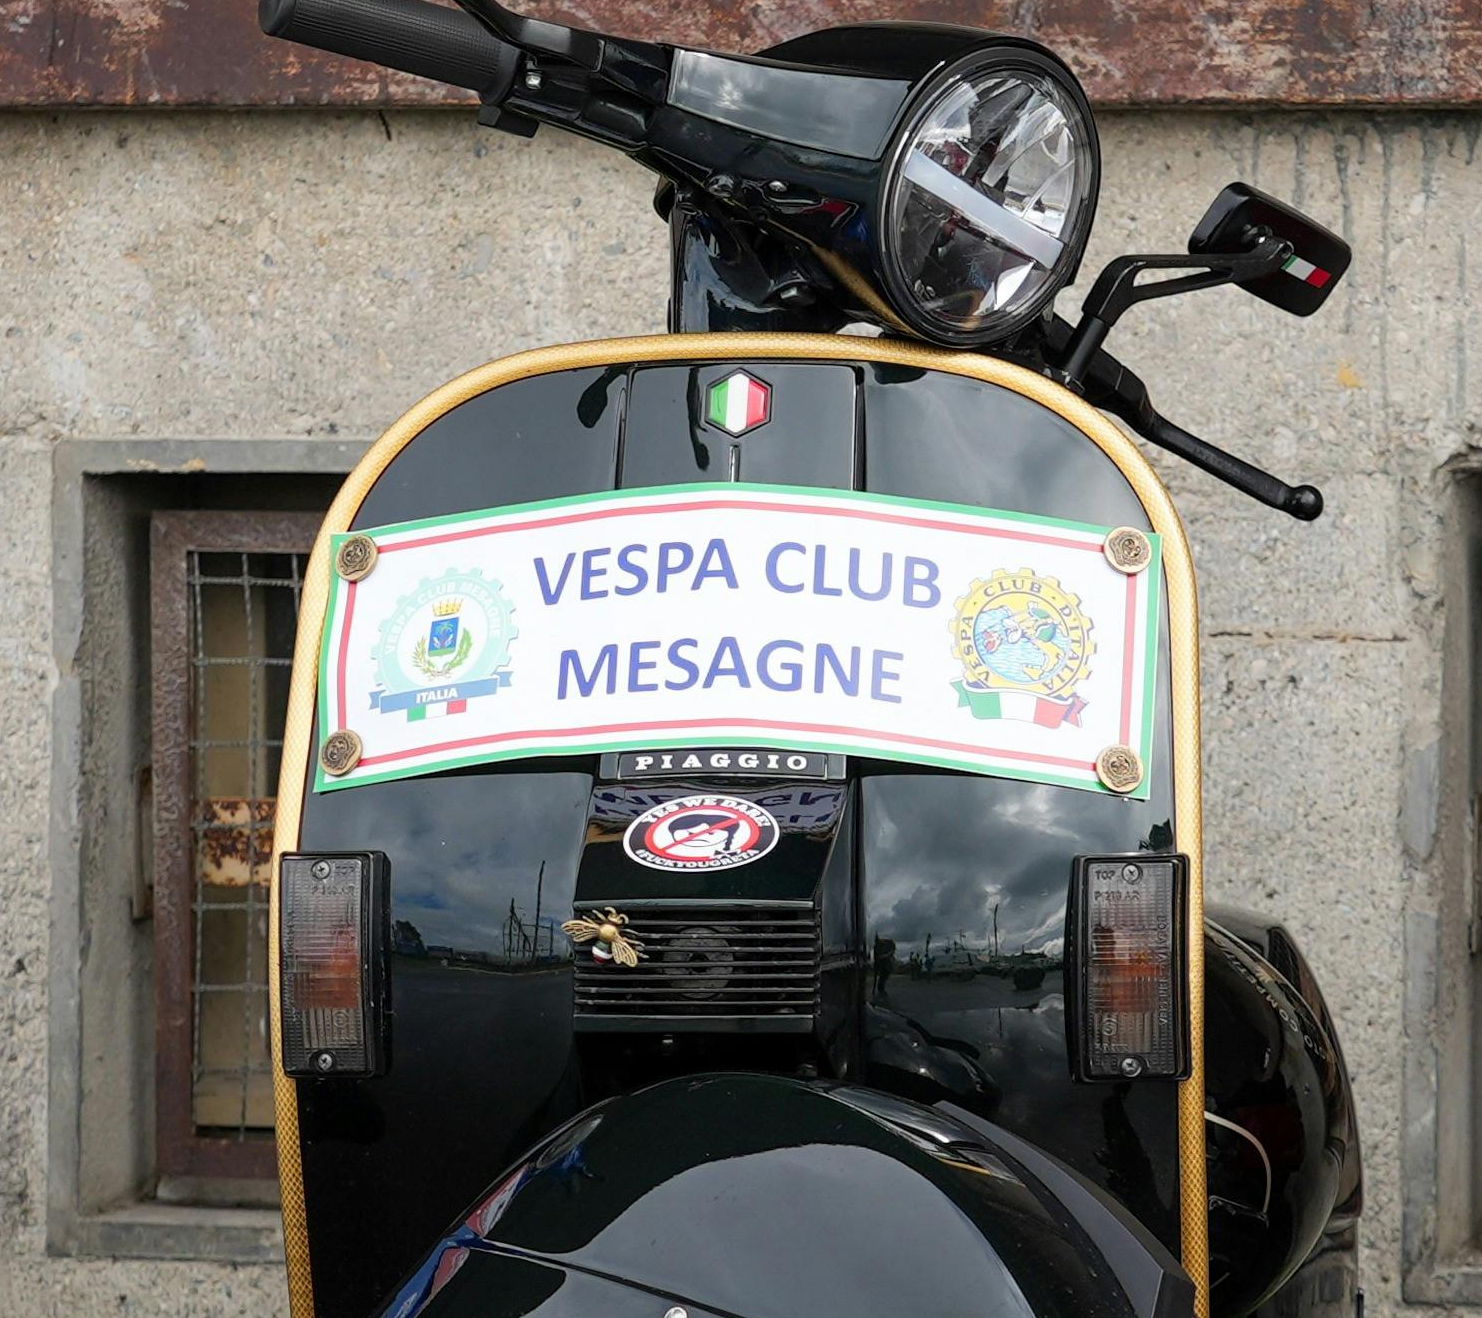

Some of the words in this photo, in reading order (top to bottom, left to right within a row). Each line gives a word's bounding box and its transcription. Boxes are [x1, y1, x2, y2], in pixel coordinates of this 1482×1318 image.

[533, 537, 739, 607] VESPA
[765, 541, 943, 609] CLUB
[417, 583, 456, 602] CLUB
[960, 615, 990, 681] VESPA
[983, 579, 1042, 597] CLUB
[557, 638, 904, 704] MESAGNE
[416, 687, 458, 704] ITALIA
[635, 754, 809, 771] PIAGGIO
[642, 804, 679, 824] YES
[683, 797, 717, 808] WE
